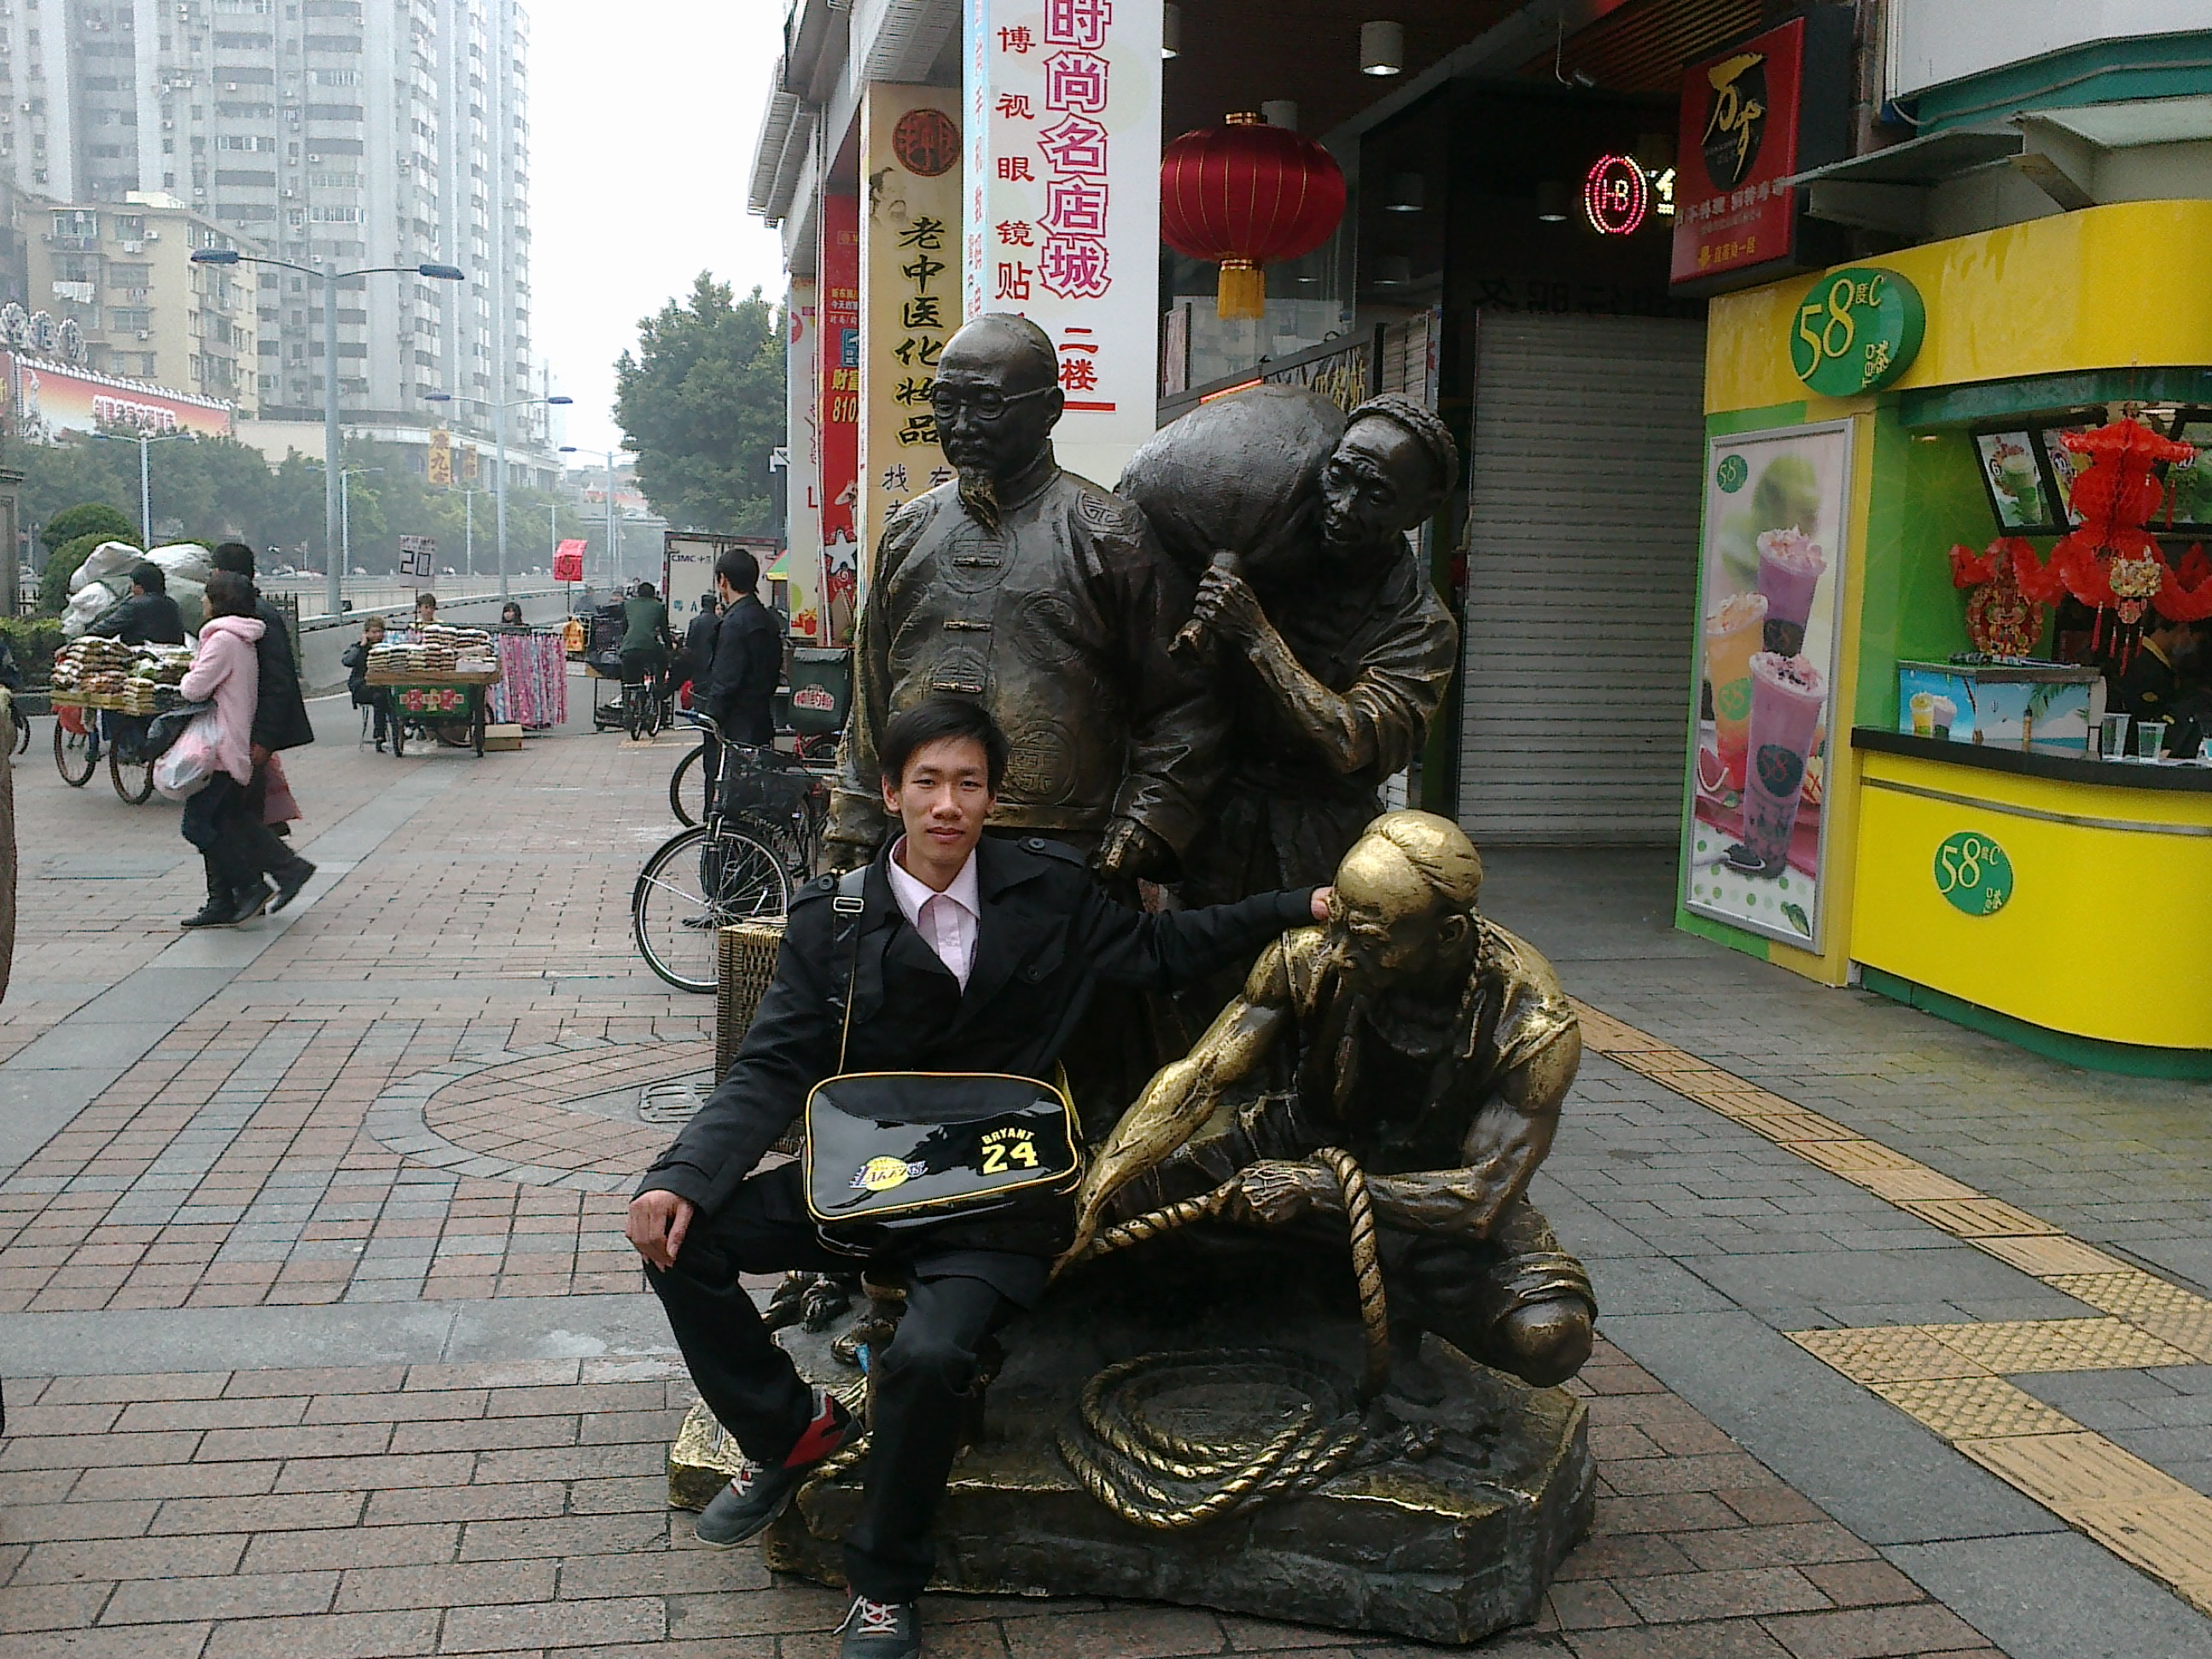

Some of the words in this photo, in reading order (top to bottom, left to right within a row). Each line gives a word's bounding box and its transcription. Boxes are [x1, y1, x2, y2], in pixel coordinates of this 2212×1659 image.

[995, 26, 1036, 318] 博视眼镜贴
[895, 216, 946, 446] 老中医化妆品
[1059, 327, 1099, 392] 二楼
[832, 396, 859, 423] 810
[400, 550, 431, 577] 20
[672, 555, 696, 563] CIMC
[981, 1127, 1035, 1145] BRYANT
[982, 1141, 1039, 1175] 24
